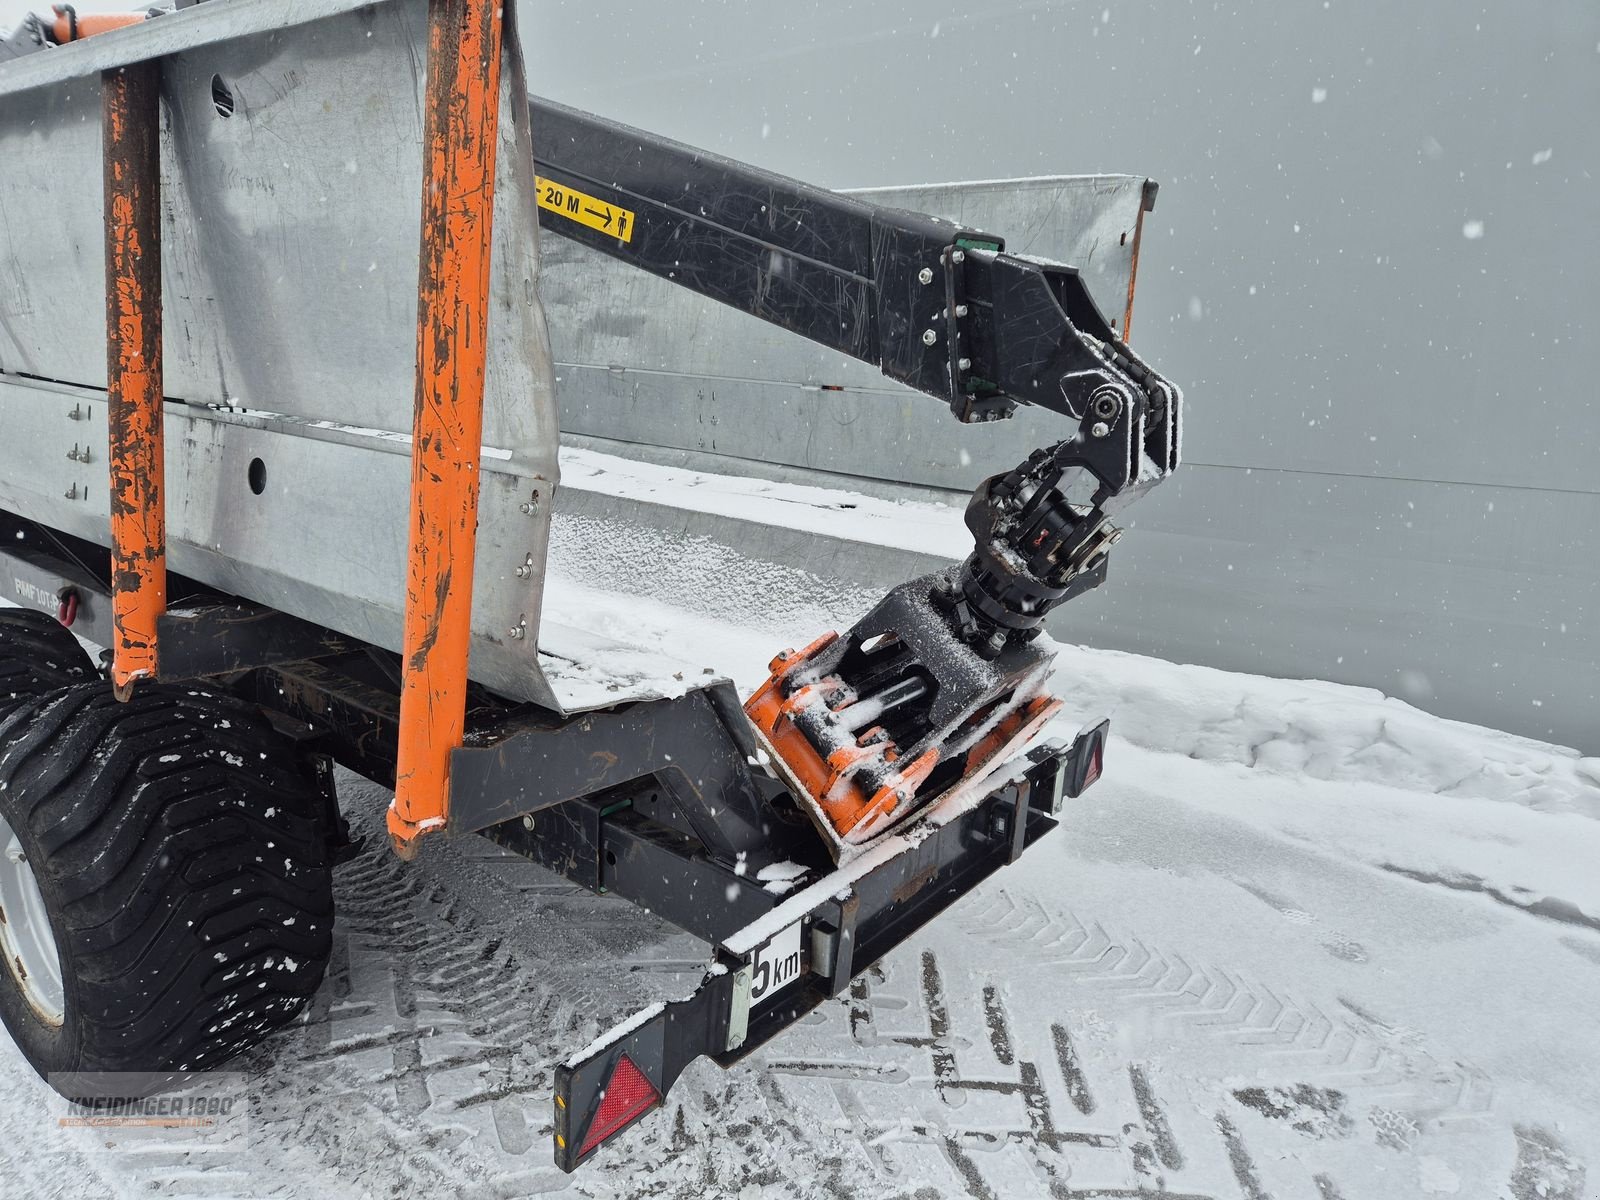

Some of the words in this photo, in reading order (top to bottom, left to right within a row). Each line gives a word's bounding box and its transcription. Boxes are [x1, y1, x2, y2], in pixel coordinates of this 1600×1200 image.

[545, 187, 563, 207] 20
[566, 195, 580, 214] M
[745, 939, 771, 999] 5
[773, 951, 799, 987] km
